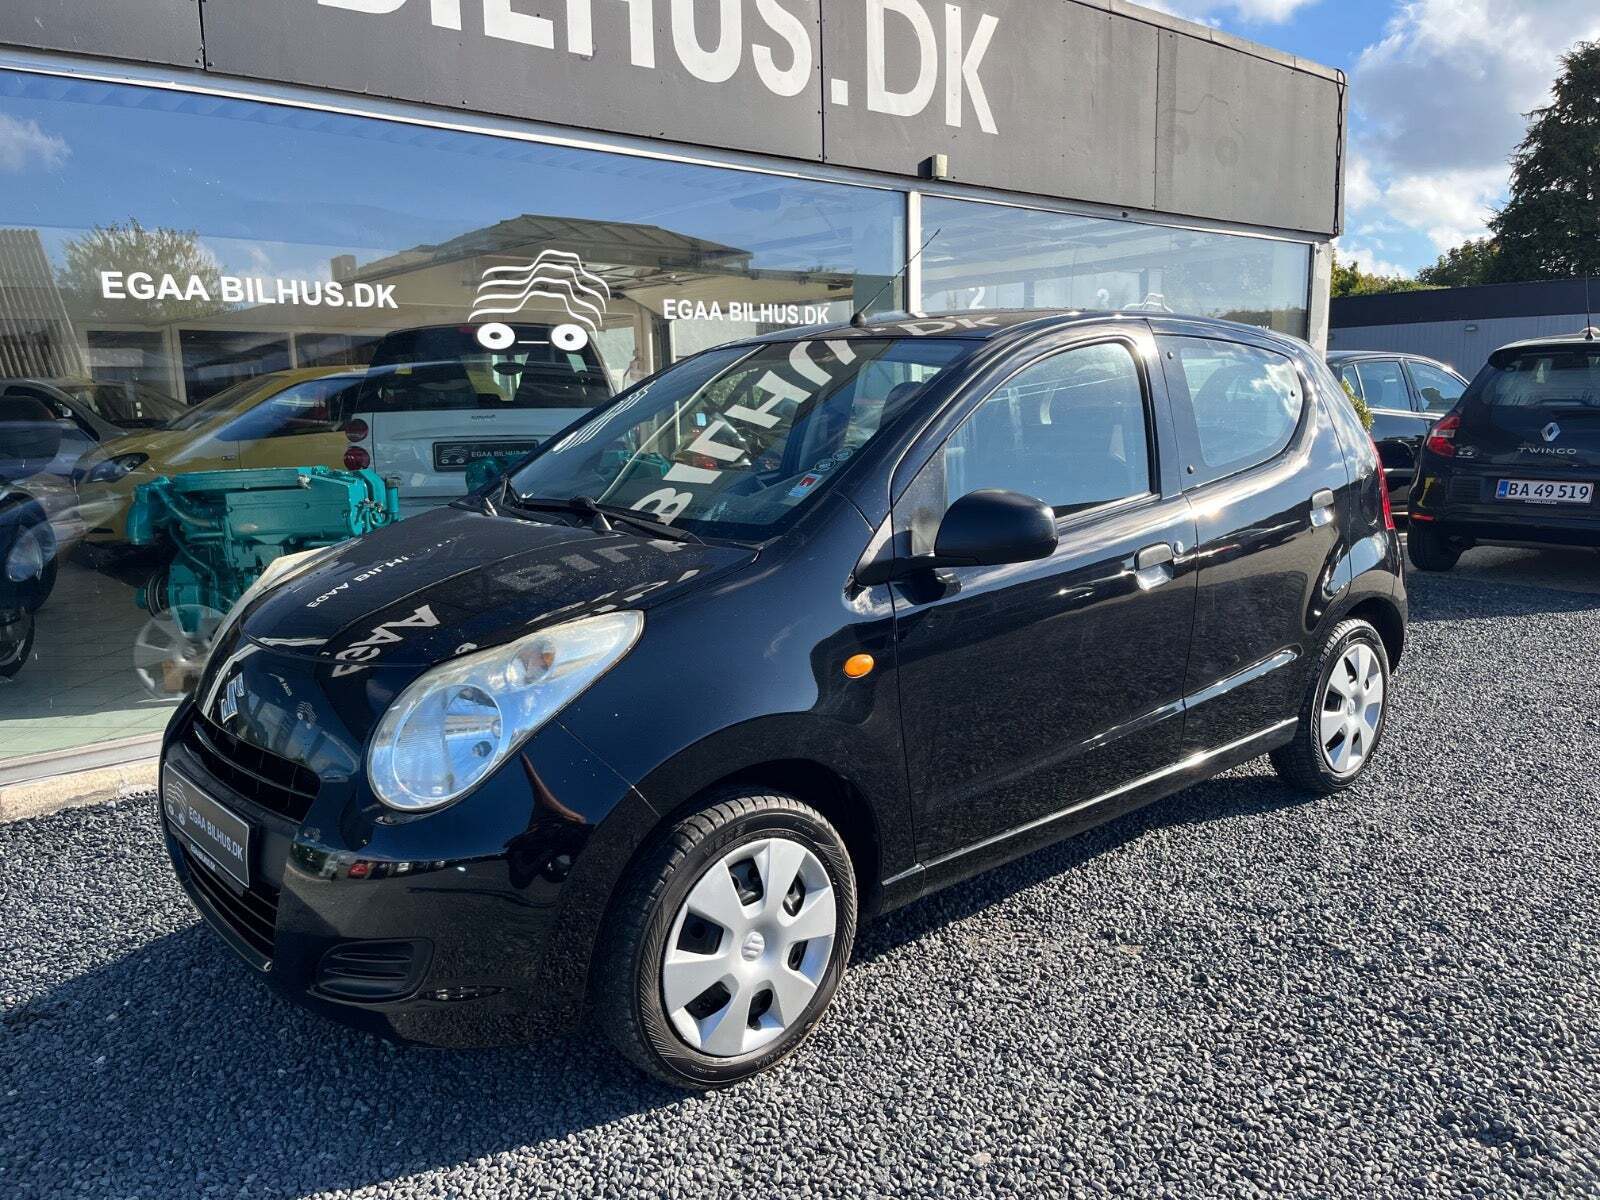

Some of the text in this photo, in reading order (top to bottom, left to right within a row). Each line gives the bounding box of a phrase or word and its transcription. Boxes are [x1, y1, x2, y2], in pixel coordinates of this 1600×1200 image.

[315, 0, 999, 136] US.DK
[100, 270, 399, 309] EGAA BILHUS.DK
[968, 286, 985, 309] 2
[663, 298, 832, 325] EGAA BILHUS.DK
[1517, 447, 1577, 455] TWINGO
[1508, 482, 1590, 499] BA 49 519
[188, 806, 207, 832] EGAA
[207, 822, 244, 862] BILHUS.DK
